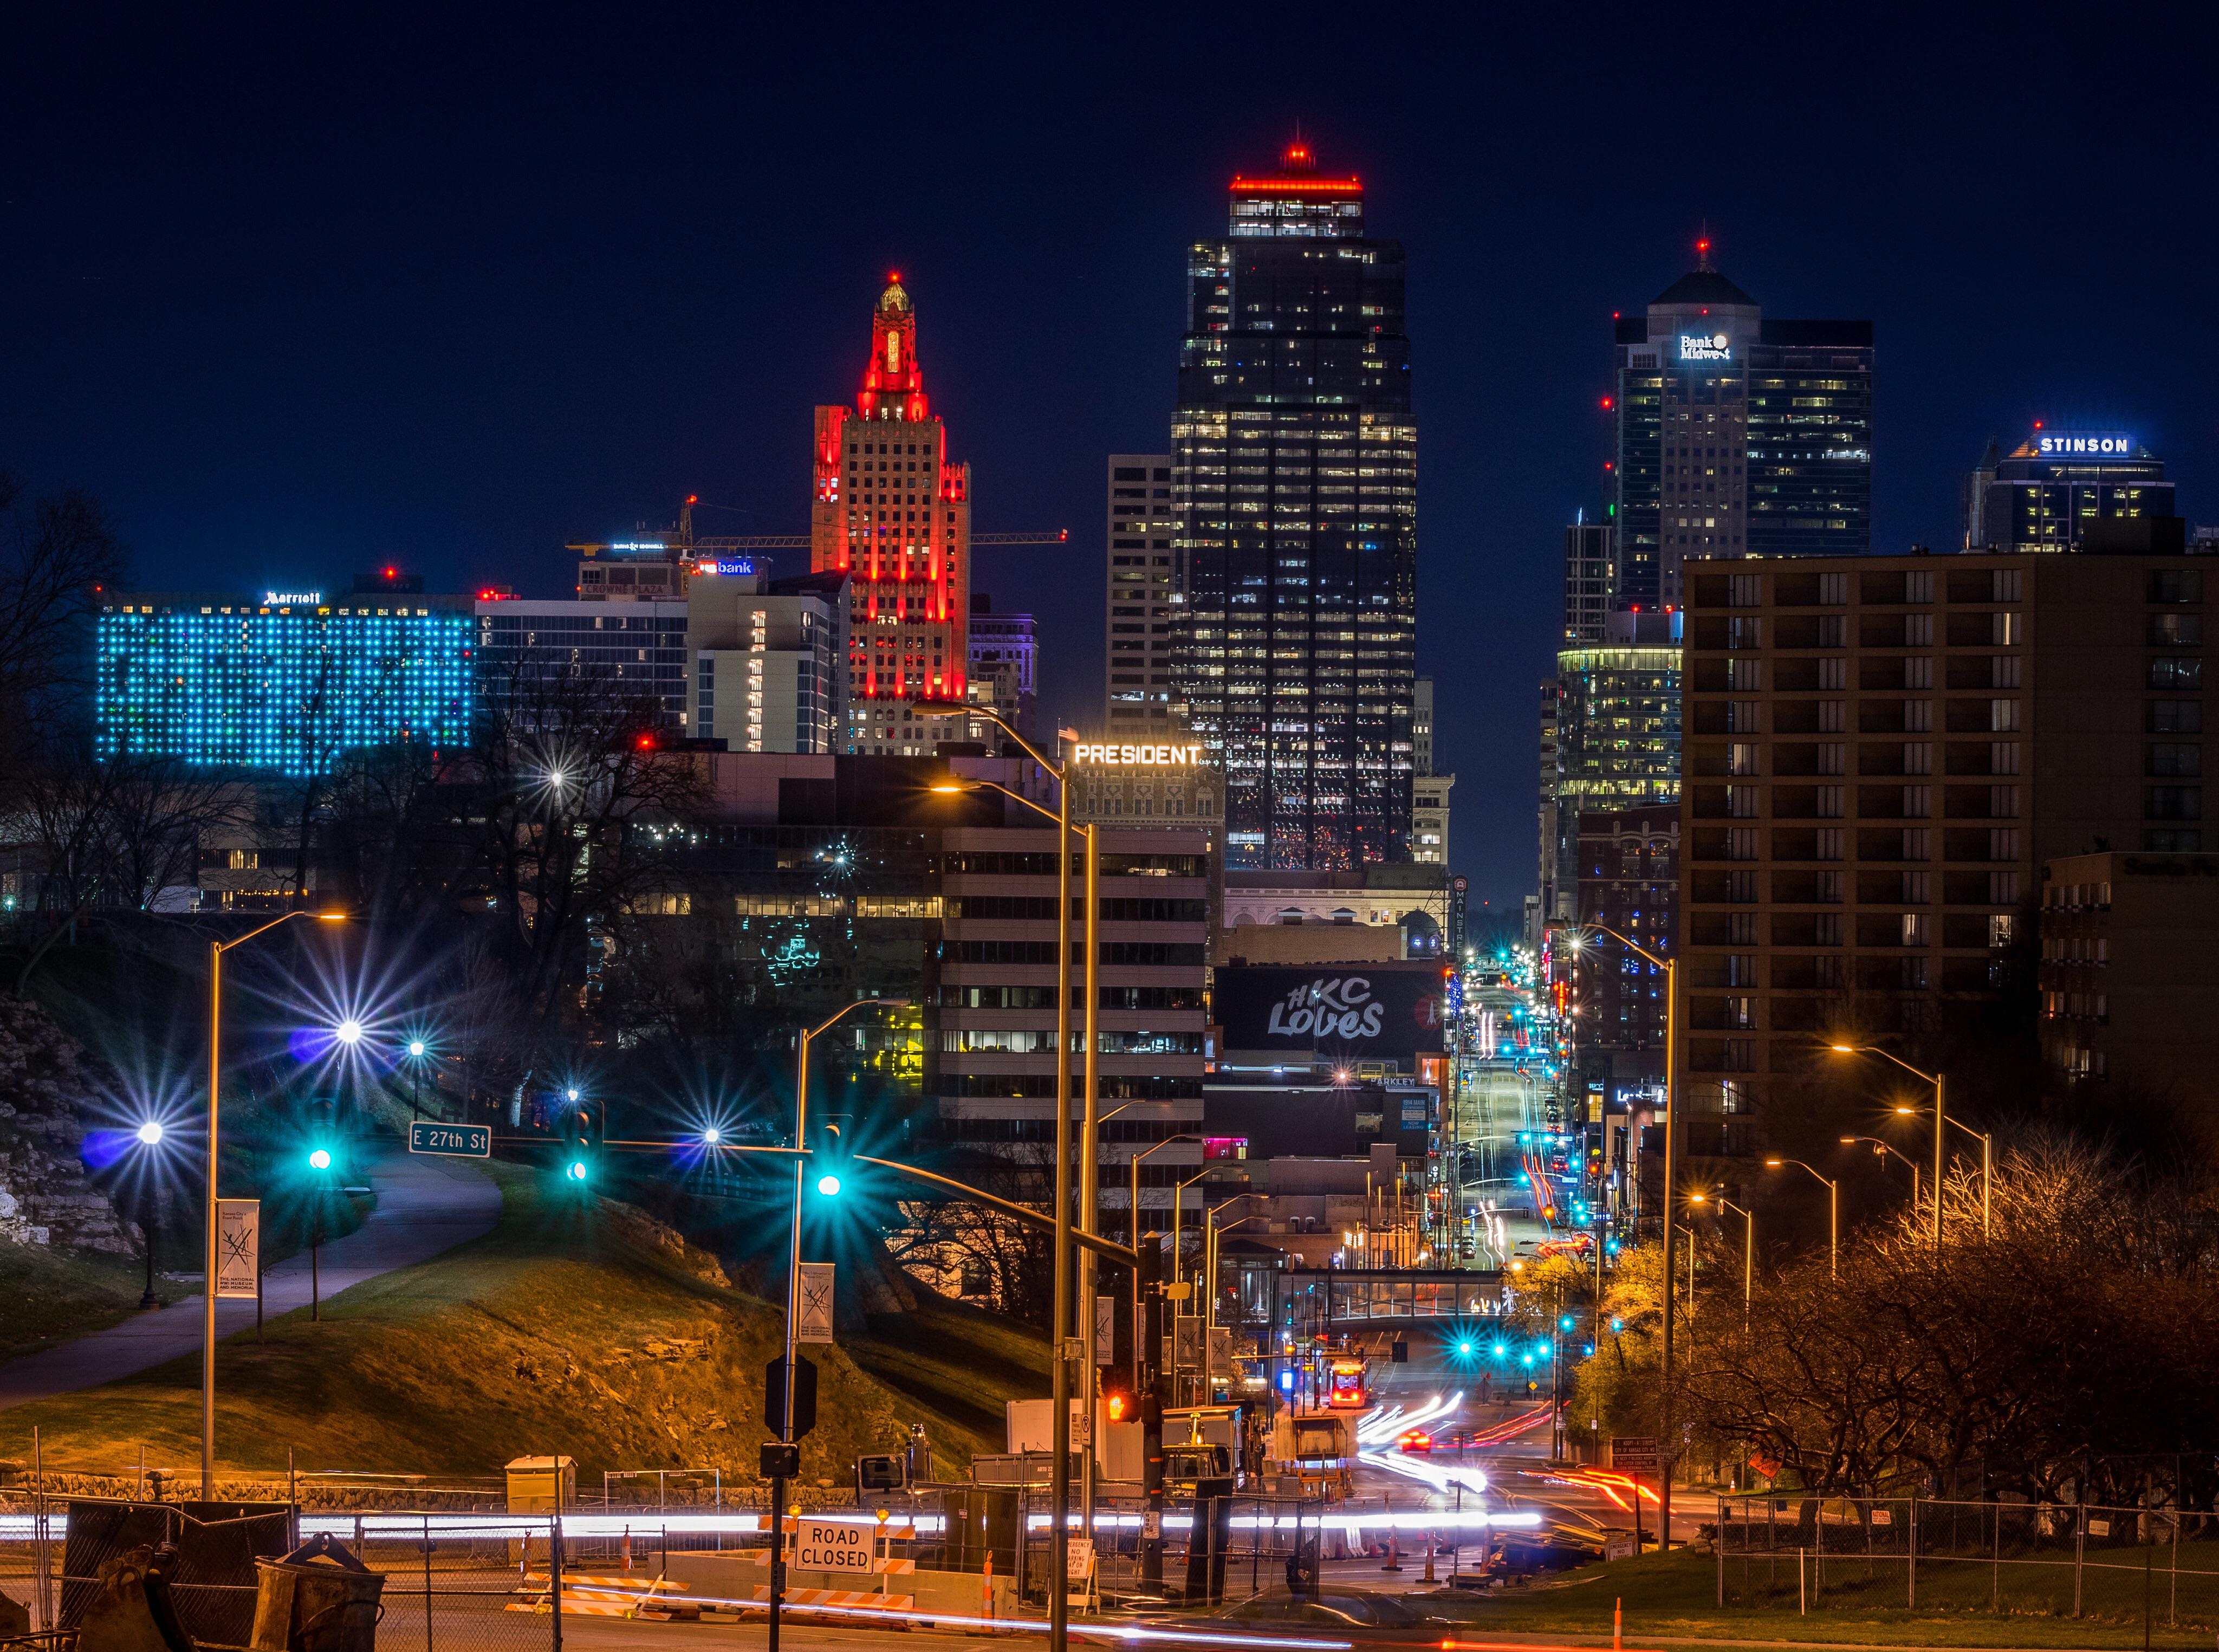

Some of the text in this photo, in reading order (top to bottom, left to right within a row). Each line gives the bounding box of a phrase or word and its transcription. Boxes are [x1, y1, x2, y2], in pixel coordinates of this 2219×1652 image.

[1681, 336, 1713, 348] Bank
[1681, 347, 1730, 359] Midwest
[2041, 438, 2128, 452] STINSON
[718, 562, 751, 573] bank
[586, 585, 664, 594] CROWNE PLAZA
[263, 592, 320, 605] Marriott
[1075, 744, 1201, 765] PRESIDENT
[414, 1130, 486, 1149] E 27th St
[812, 1528, 859, 1545] ROAD
[802, 1549, 868, 1567] CLOSED
